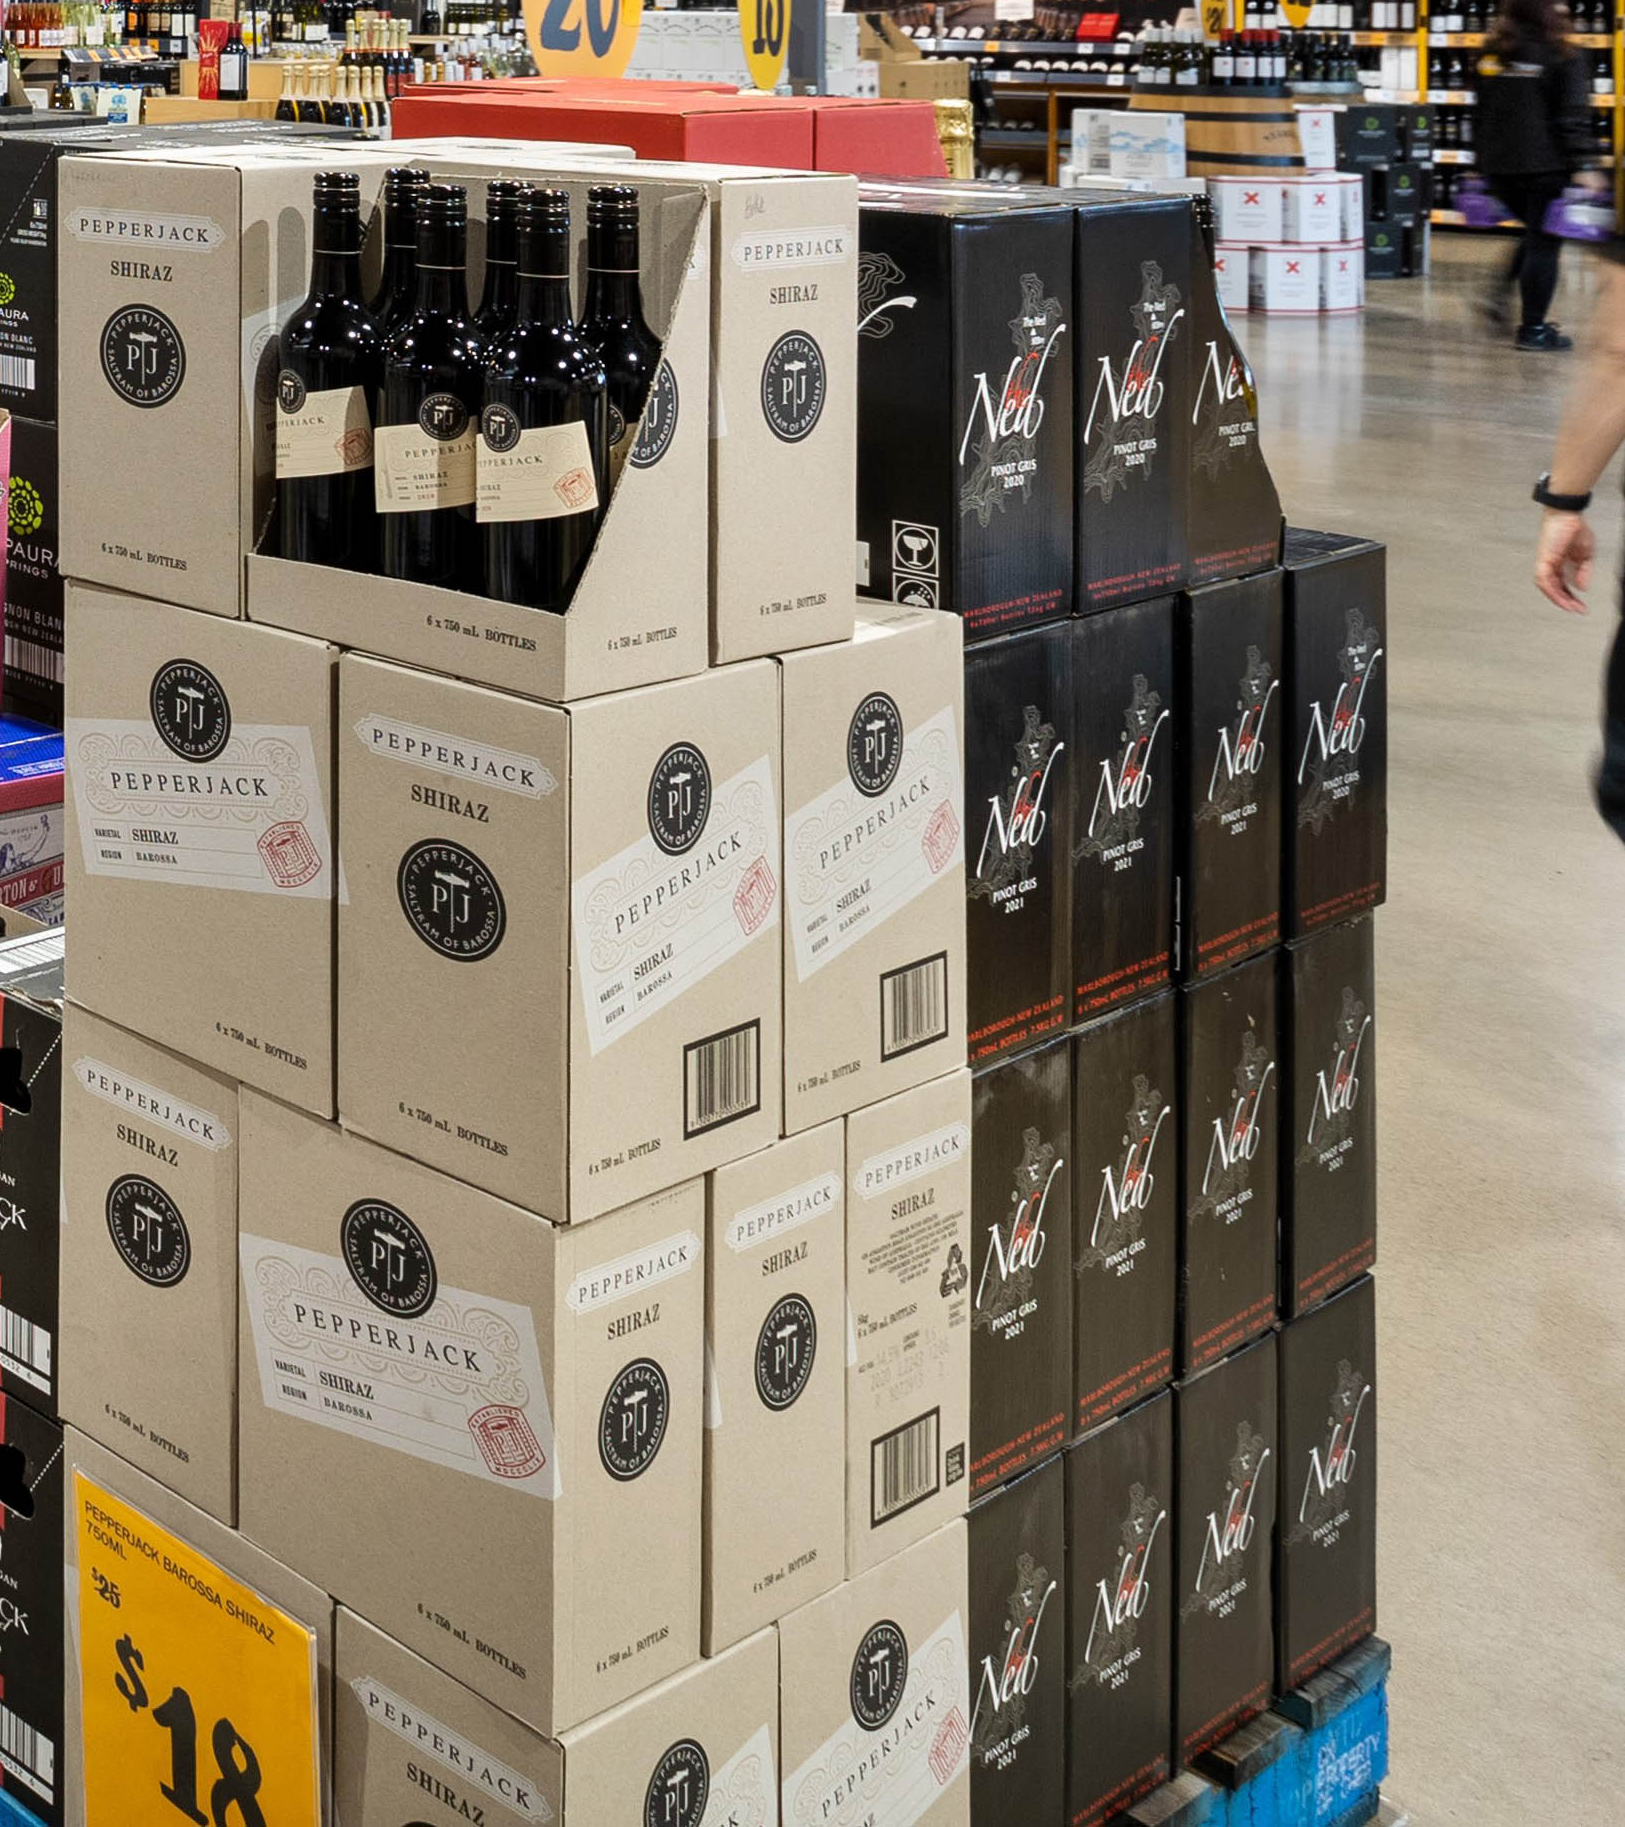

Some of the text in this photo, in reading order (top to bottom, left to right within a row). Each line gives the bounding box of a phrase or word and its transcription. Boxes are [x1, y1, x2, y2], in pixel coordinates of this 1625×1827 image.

[80, 219, 208, 243] PEPPERJACK
[111, 261, 173, 282] SHIRAZ
[11, 334, 33, 344] BLANC
[959, 324, 1066, 466] Ned
[991, 459, 1037, 477] PINOT GRIS
[1003, 475, 1024, 489] 2020
[110, 772, 268, 796] PEPPERJACK
[94, 828, 179, 844] VARIETAL SHIRAZ
[101, 850, 177, 863] REGION BAROSSA
[86, 1520, 127, 1561] 750ML
[85, 1501, 275, 1644] PEPPERJACK BAROSSA SHIRAZ
